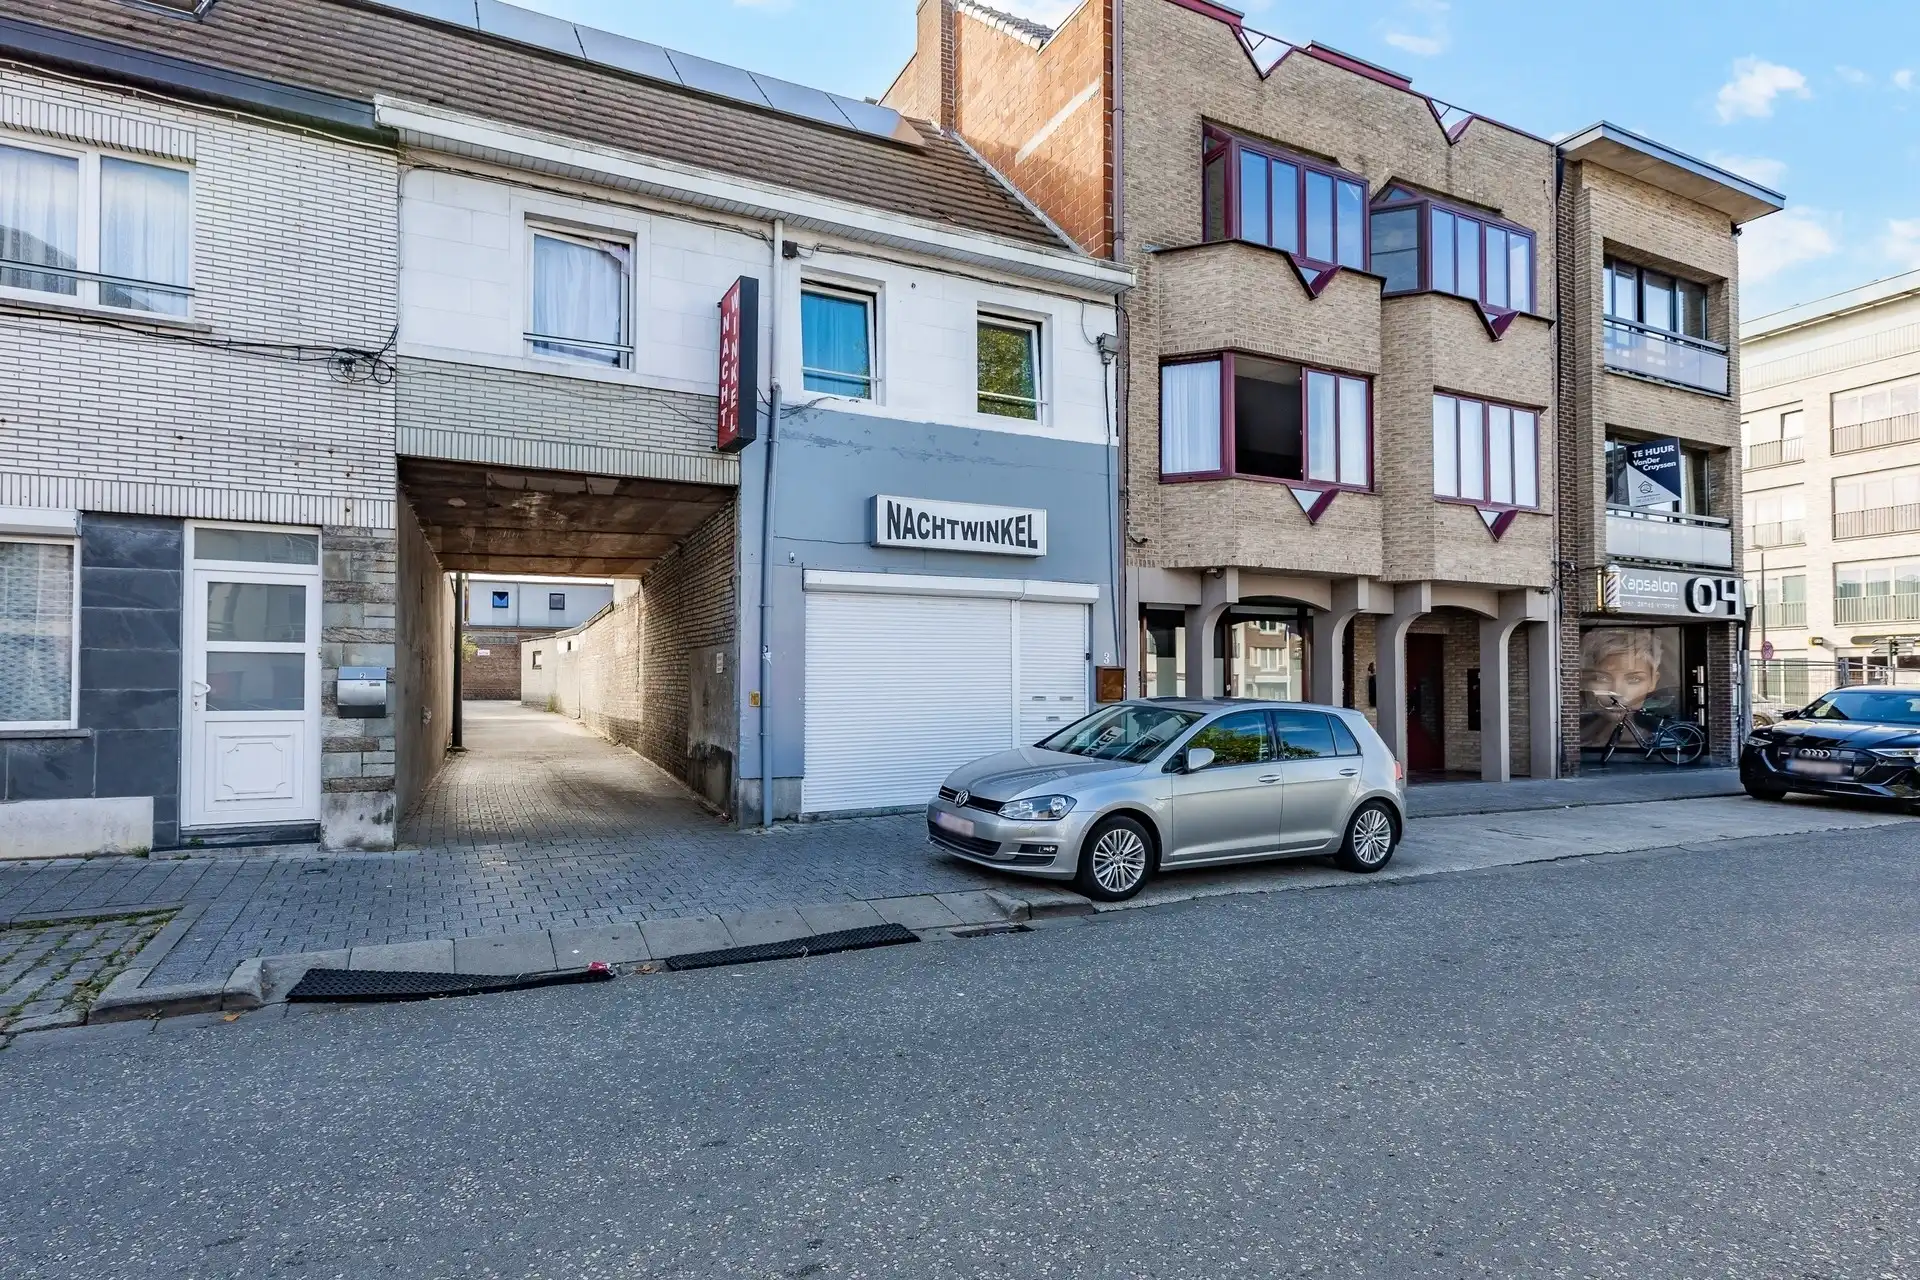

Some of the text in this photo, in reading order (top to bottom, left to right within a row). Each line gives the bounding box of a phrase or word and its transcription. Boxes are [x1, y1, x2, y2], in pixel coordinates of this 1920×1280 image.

[720, 313, 730, 428] NACHT
[730, 288, 740, 433] WINKEL
[1632, 445, 1675, 458] TE HUUR
[1643, 461, 1677, 471] Cruyssen
[887, 500, 1038, 549] NACHTWINKEL
[1620, 574, 1740, 615] Kapsalon 04
[1103, 652, 1110, 665] 3
